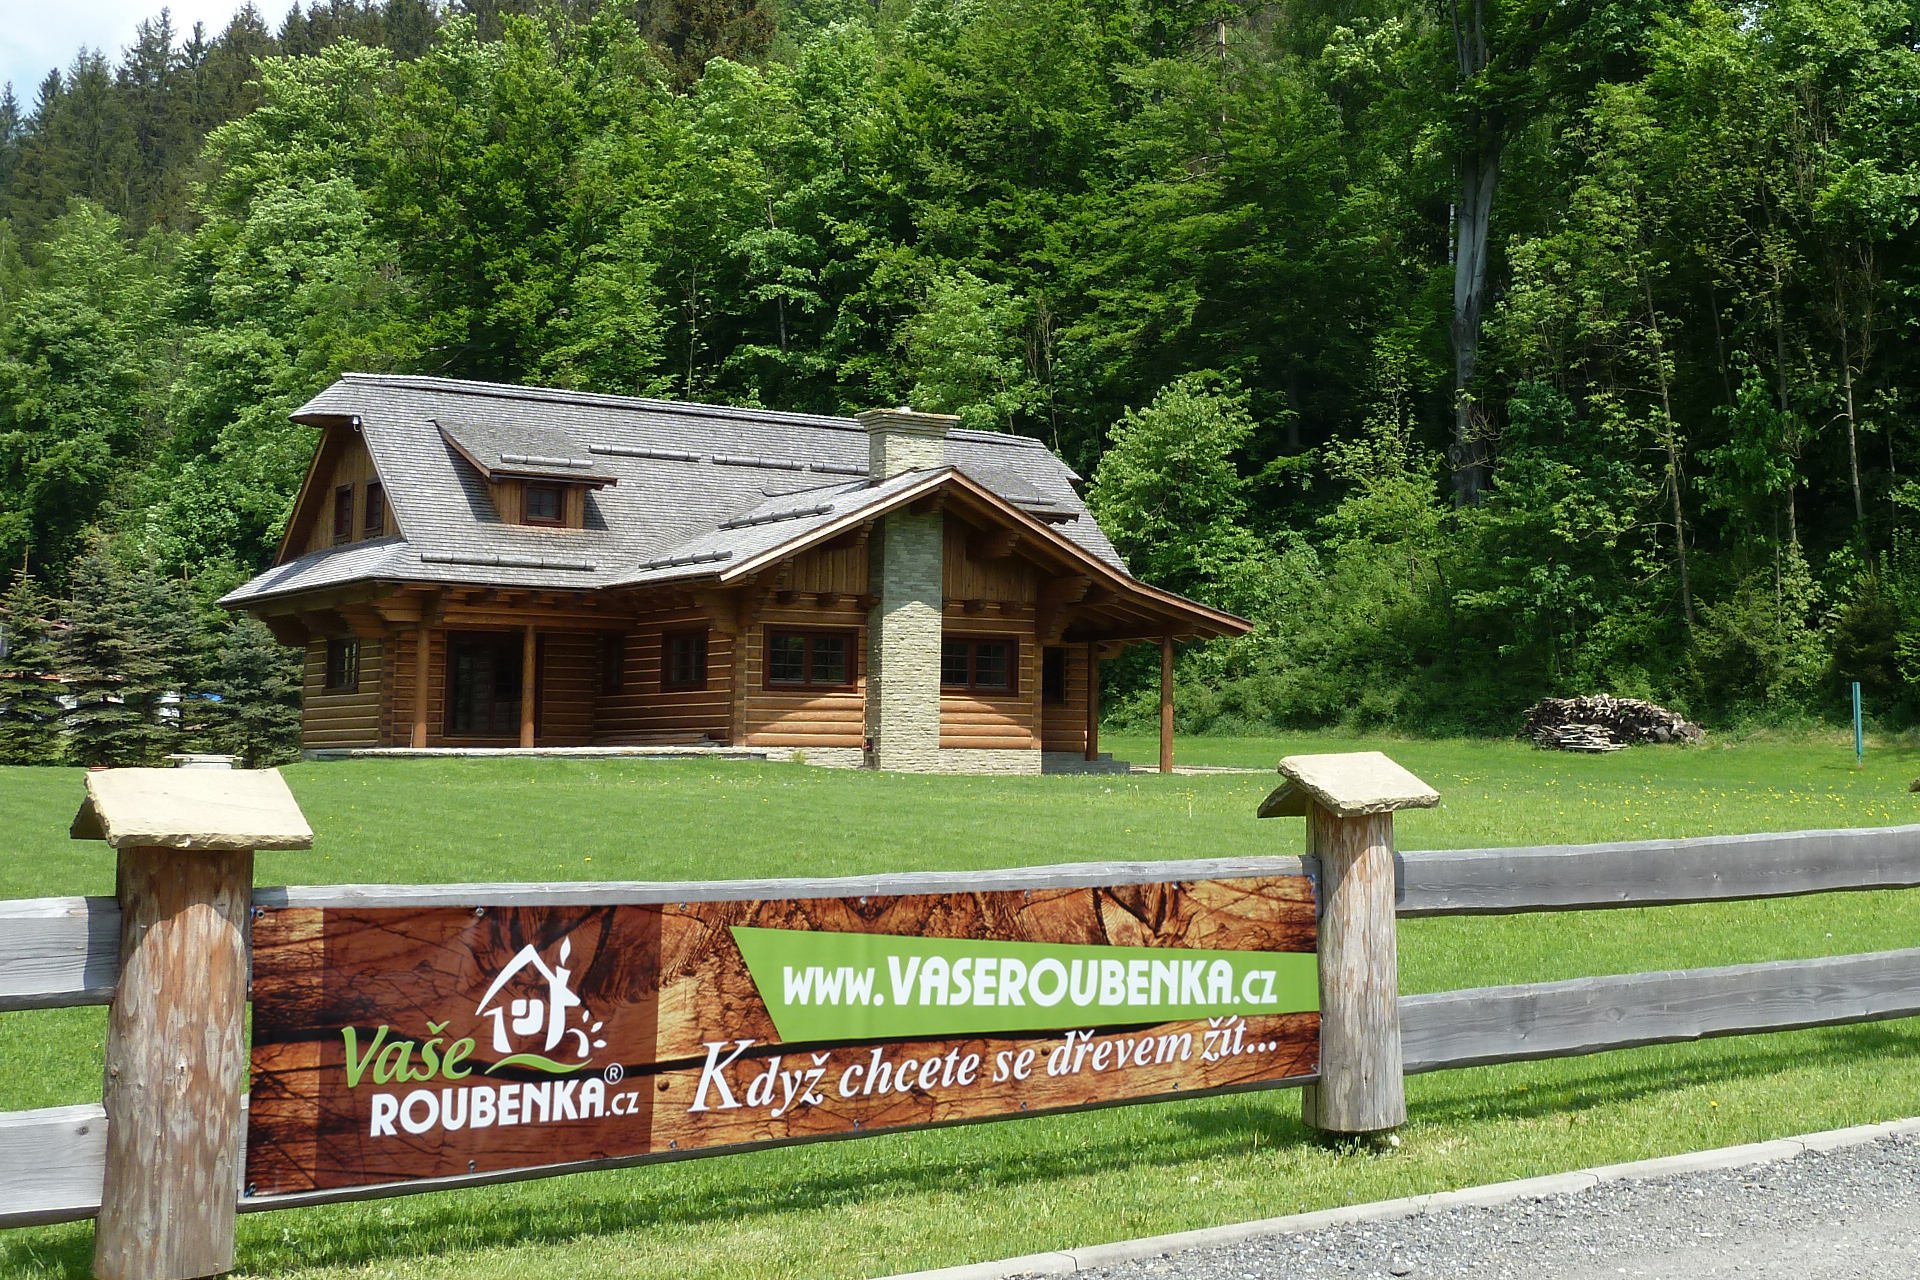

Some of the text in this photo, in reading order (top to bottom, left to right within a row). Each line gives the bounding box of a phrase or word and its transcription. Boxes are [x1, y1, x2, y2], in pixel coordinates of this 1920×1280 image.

[341, 1021, 476, 1089] Vaše
[687, 1038, 832, 1118] Když
[838, 1046, 980, 1099] chcete
[992, 1049, 1036, 1083] se
[1047, 1028, 1192, 1077] dřevem
